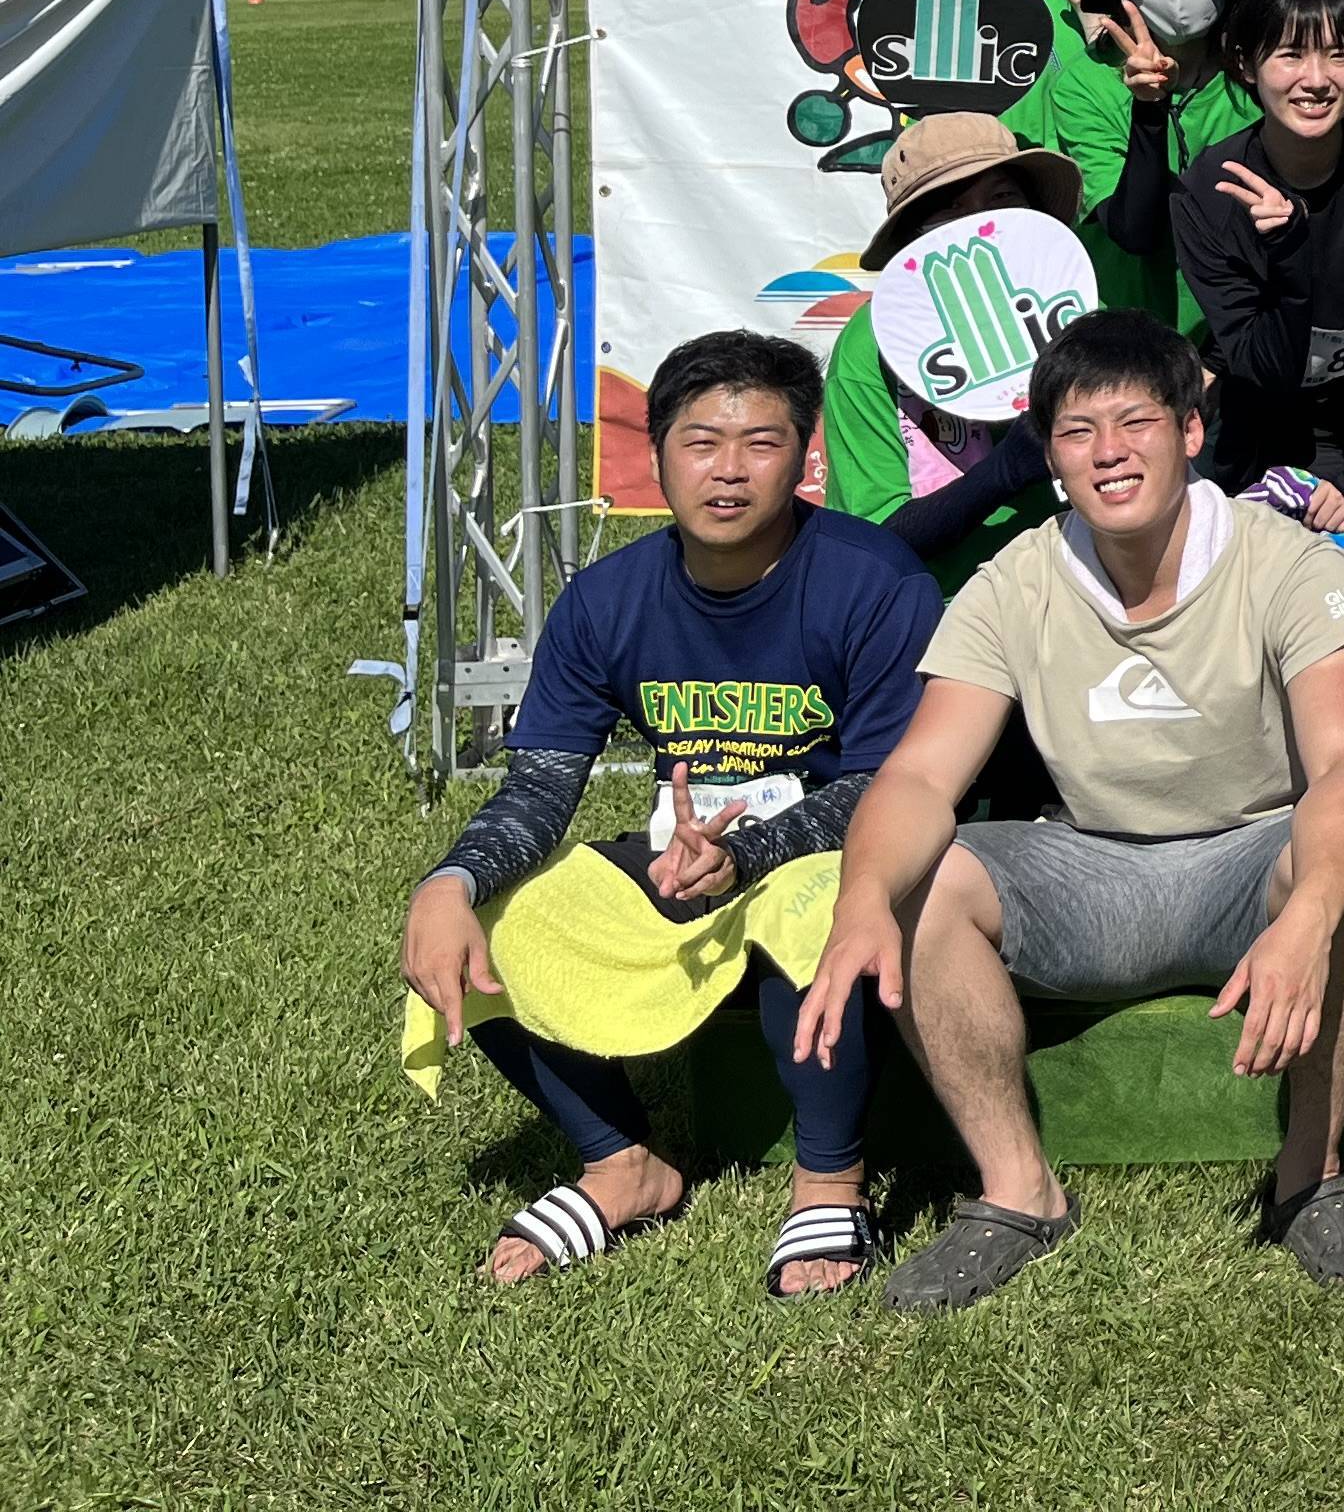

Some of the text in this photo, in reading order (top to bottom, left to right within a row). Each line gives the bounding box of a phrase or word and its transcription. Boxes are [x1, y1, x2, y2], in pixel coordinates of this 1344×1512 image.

[667, 738, 714, 756] RELAY
[715, 739, 783, 758] MARATHON
[716, 755, 765, 776] JAPAN
